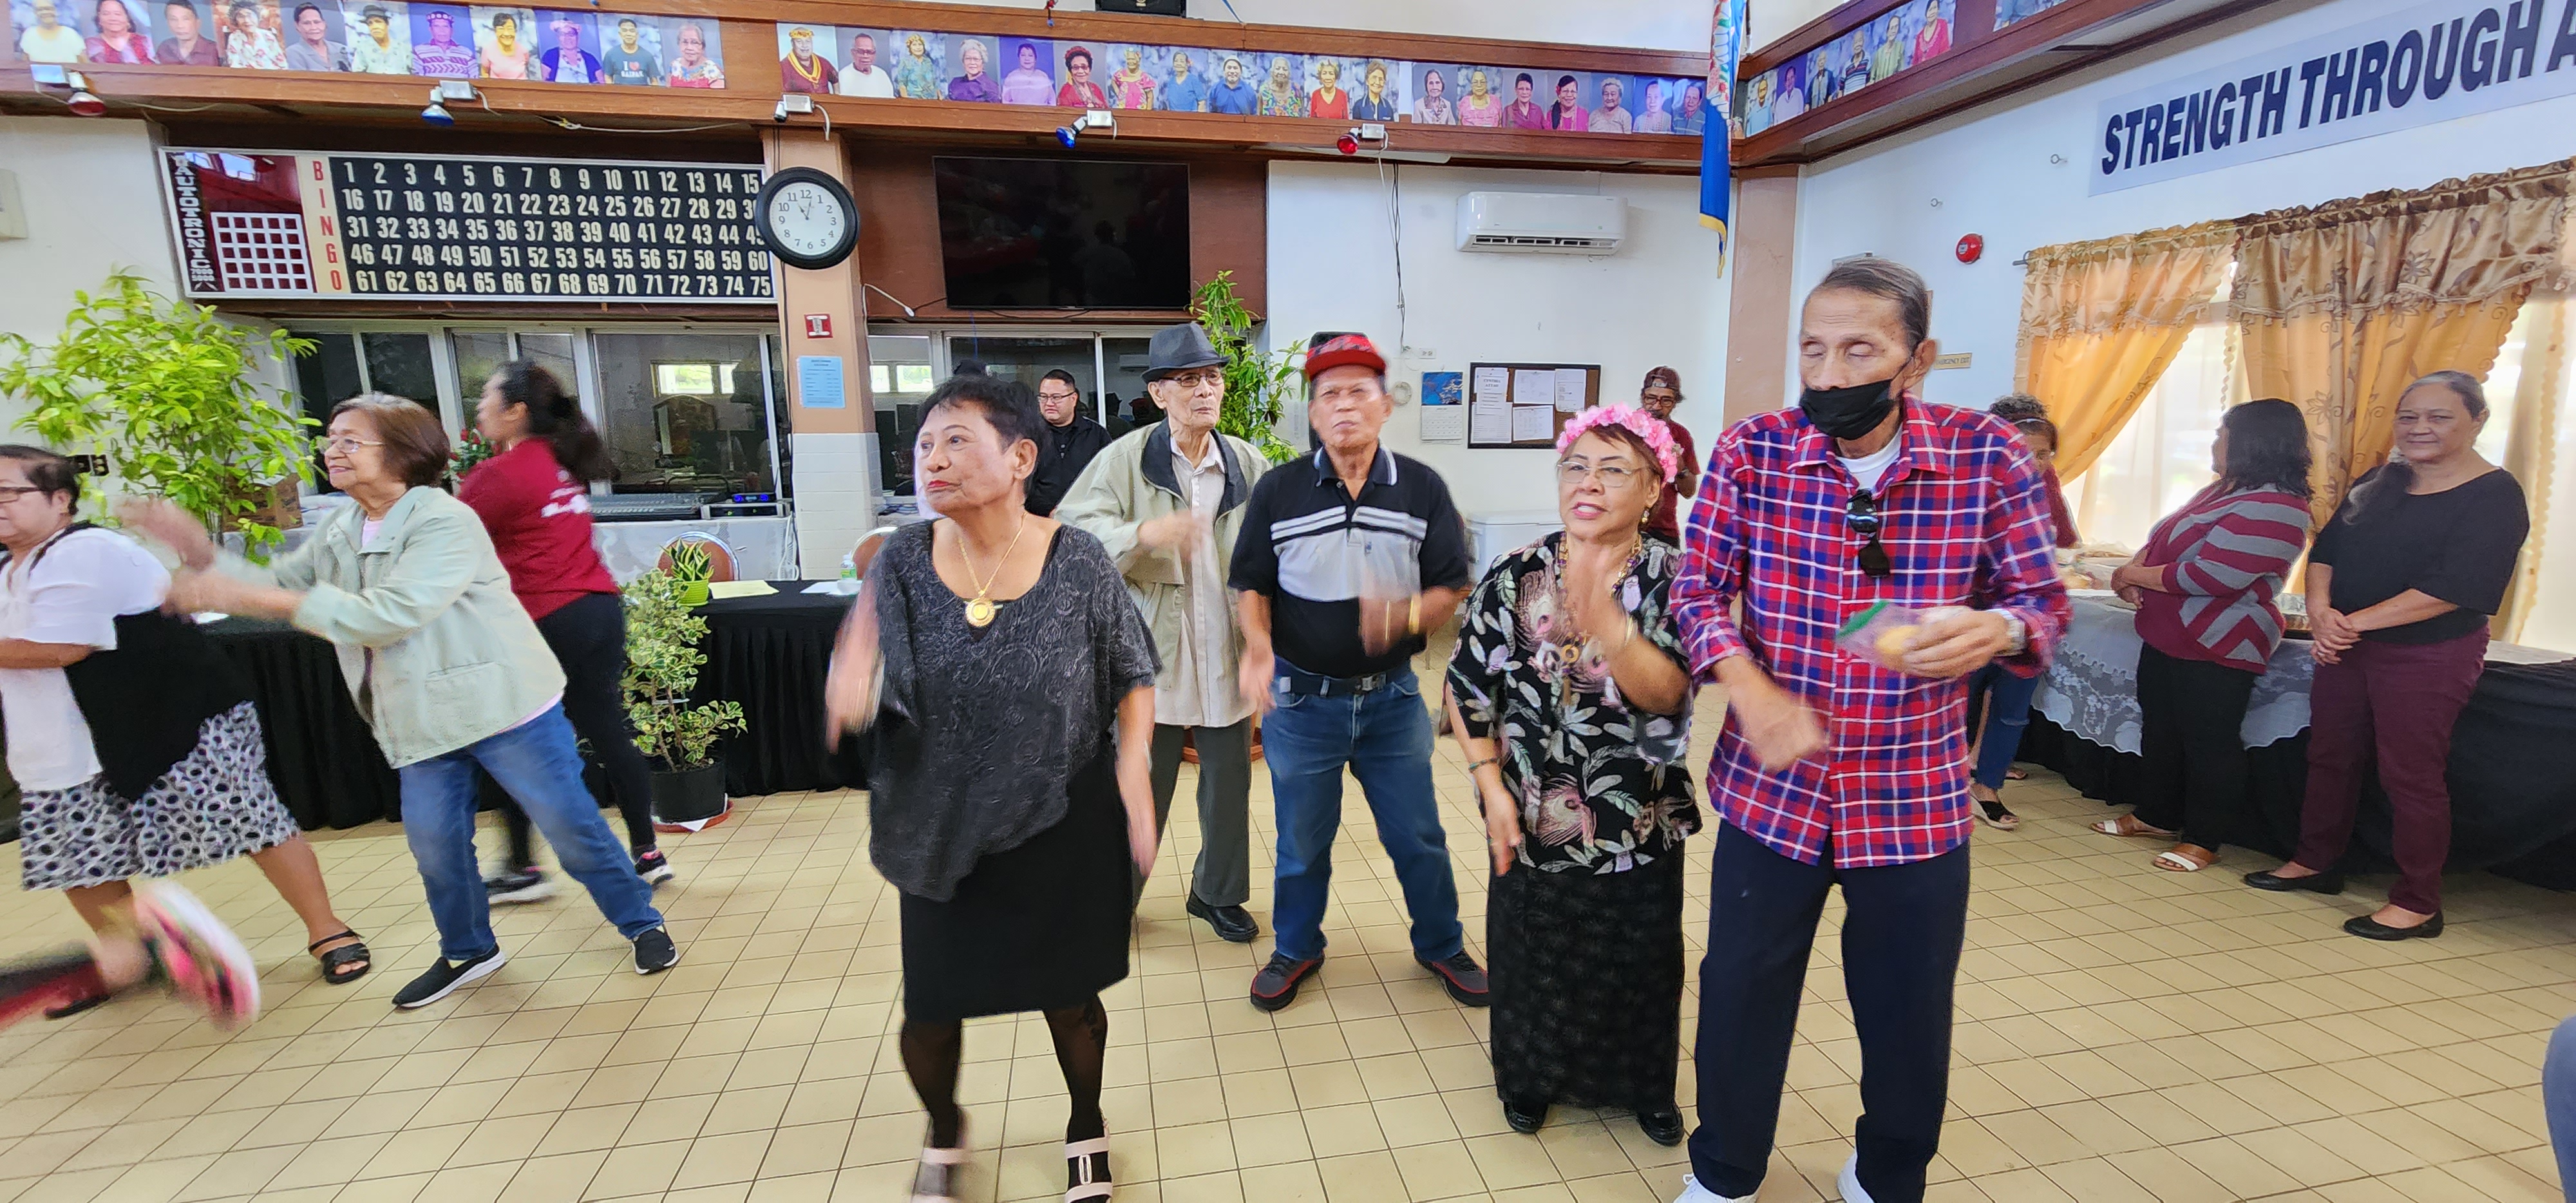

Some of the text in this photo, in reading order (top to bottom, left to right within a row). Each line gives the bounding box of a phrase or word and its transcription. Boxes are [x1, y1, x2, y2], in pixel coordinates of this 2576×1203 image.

[2101, 66, 2293, 176] STRENGTH
[2299, 0, 2544, 129] THROUGH
[344, 162, 759, 194] 1 2 3 4 5 6 7 8 9 10 11 12 13 14 15
[787, 192, 798, 202] 11
[800, 189, 812, 199] 12
[817, 194, 823, 204] 1
[342, 189, 365, 211] 16
[373, 189, 393, 211] 17
[403, 190, 425, 212] 18
[432, 191, 454, 213] 19
[461, 191, 485, 214] 20
[491, 193, 513, 214] 21
[519, 193, 542, 215] 22
[547, 194, 571, 216] 23
[576, 194, 600, 216] 24
[604, 195, 627, 217] 25
[632, 196, 655, 217] 26
[660, 197, 681, 218] 27
[688, 198, 710, 219] 28
[715, 198, 737, 220] 29
[778, 202, 790, 212] 10
[826, 205, 833, 214] 2
[779, 216, 785, 224] 9
[831, 217, 837, 225] 3
[346, 216, 369, 238] 31
[375, 216, 401, 238] 32
[406, 217, 431, 239] 33
[435, 218, 460, 240] 34
[465, 218, 489, 240] 35
[494, 219, 518, 241] 36
[524, 220, 544, 242] 37
[551, 221, 574, 242] 38
[580, 222, 603, 243] 39
[609, 222, 631, 243] 40
[637, 222, 657, 243] 41
[663, 223, 687, 244] 42
[692, 223, 713, 245] 43
[718, 224, 740, 245] 44
[784, 229, 791, 238] 8
[350, 243, 768, 271] 46 47 48 49 50 51 52 53 54 55 56 57 58 59 60
[355, 270, 771, 296] 61 62 63 64 65 66 67 68 69 70 71 72 73 74 75
